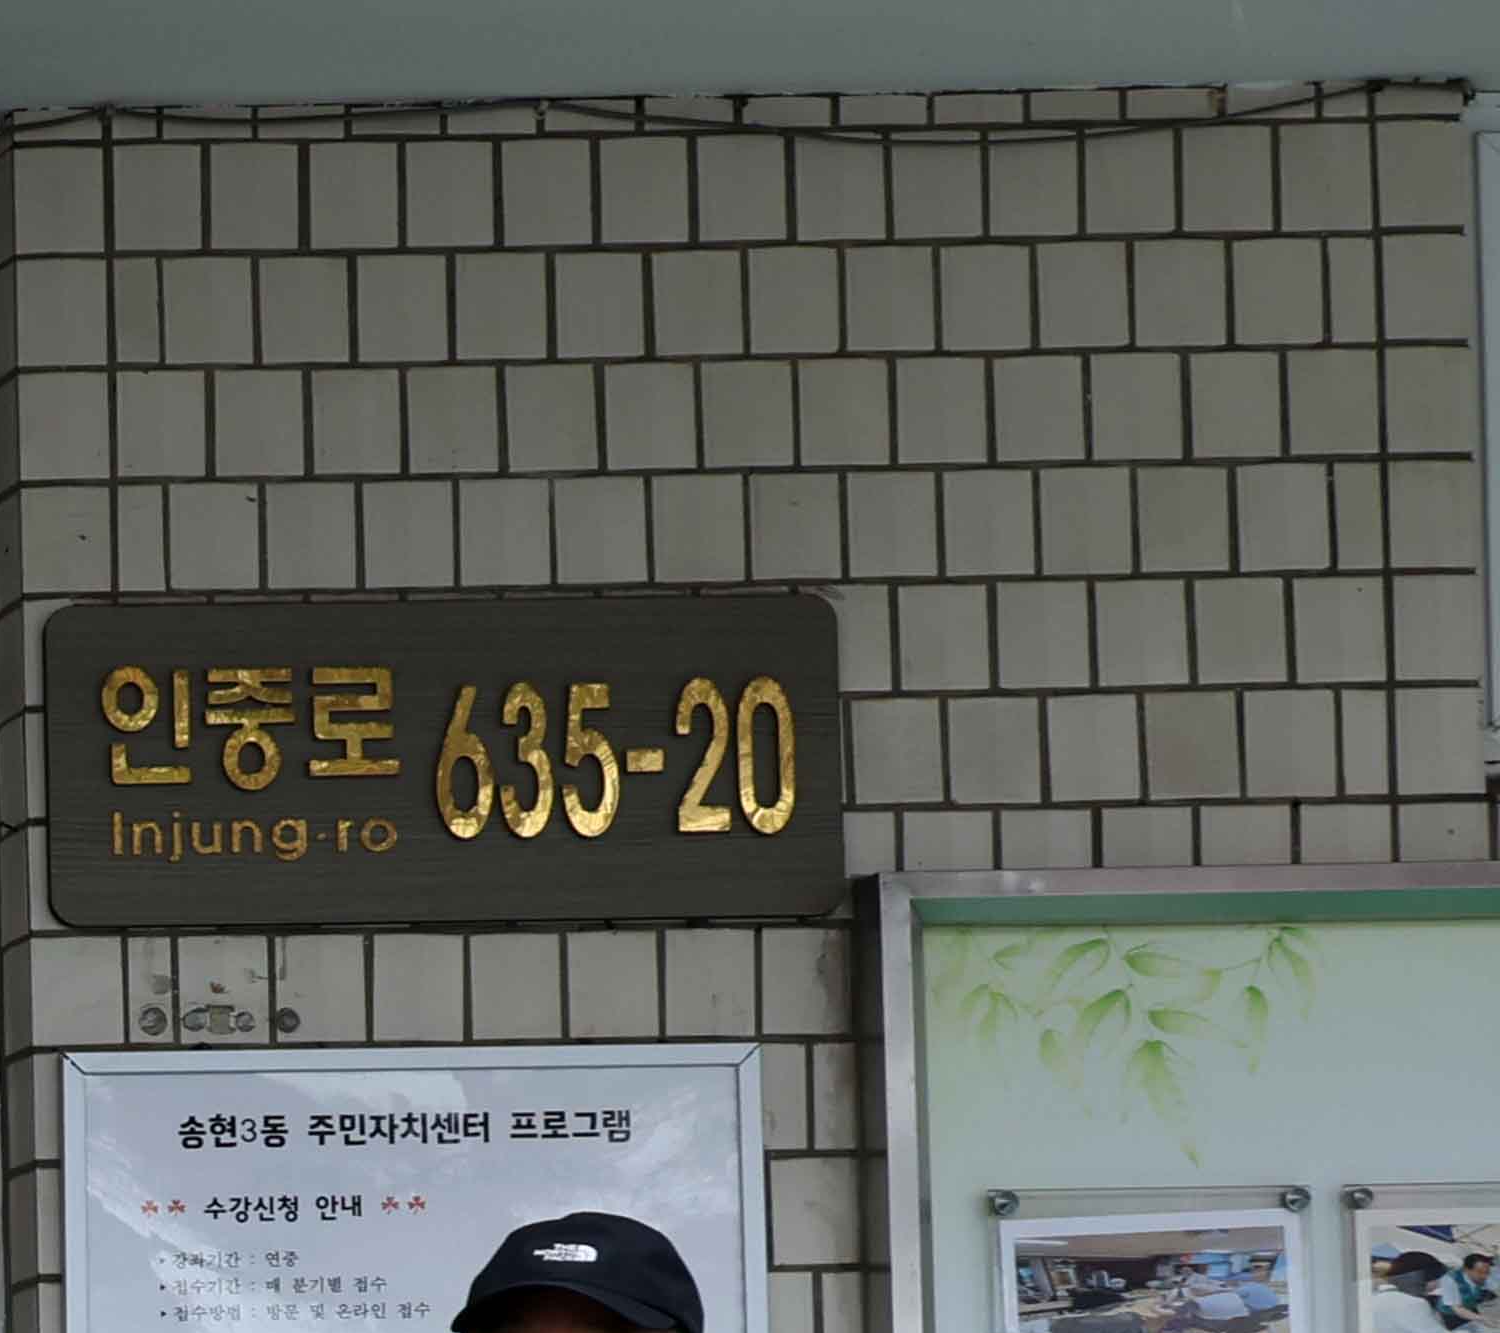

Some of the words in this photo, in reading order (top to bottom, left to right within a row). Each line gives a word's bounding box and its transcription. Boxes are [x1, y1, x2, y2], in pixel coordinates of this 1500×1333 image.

[101, 664, 401, 792] 인중로
[435, 674, 796, 839] 635-20
[177, 1113, 290, 1151] 송현3동
[306, 1111, 491, 1148] 주민자치센터
[509, 1108, 633, 1144] 프로그램
[203, 1193, 301, 1223] 수강신청
[313, 1191, 364, 1221] 안내
[264, 1250, 300, 1270] 연중
[292, 1276, 344, 1294] 분기별
[352, 1275, 388, 1294] 접수
[335, 1301, 388, 1321] 온라인
[396, 1300, 431, 1319] 접수
